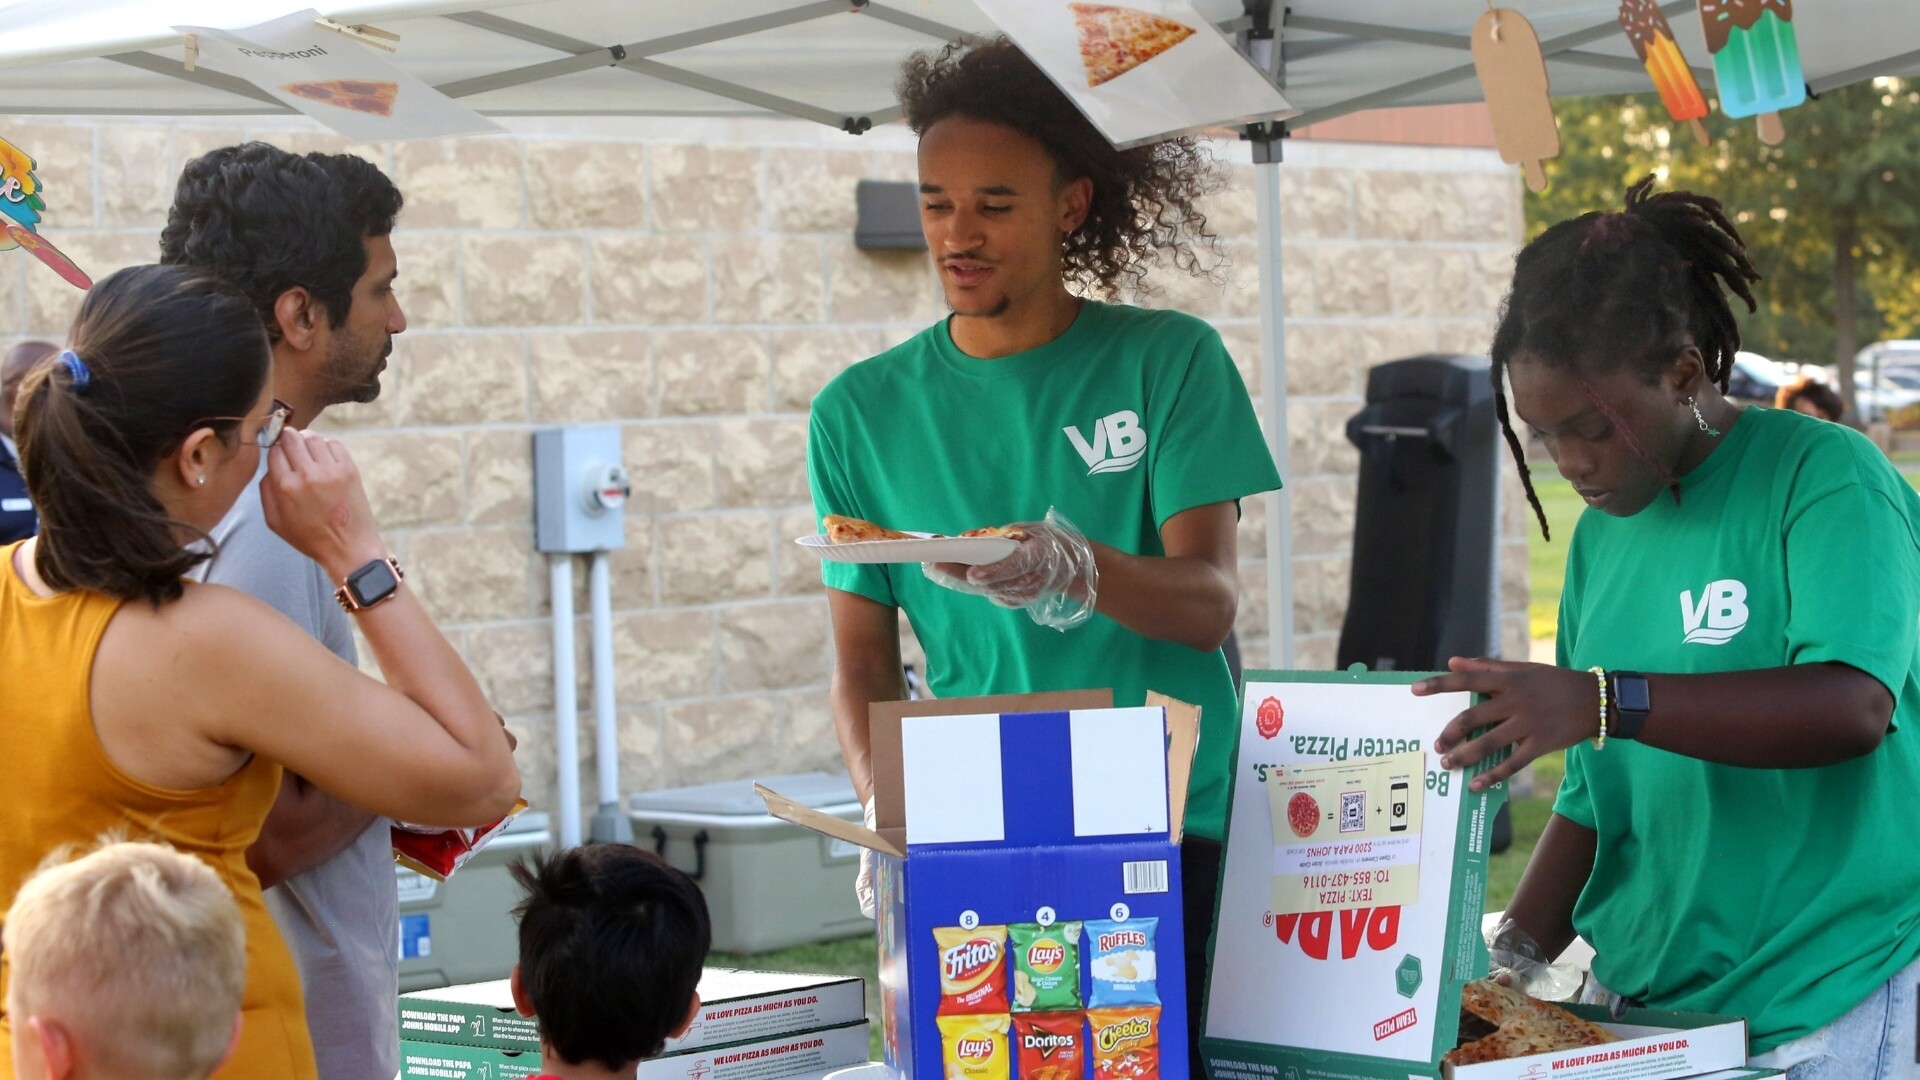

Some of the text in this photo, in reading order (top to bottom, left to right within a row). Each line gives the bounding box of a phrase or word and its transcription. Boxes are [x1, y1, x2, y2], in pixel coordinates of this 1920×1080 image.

[1063, 410, 1147, 470] VB
[1680, 579, 1749, 638] VB
[1290, 735, 1421, 762] Better Pizza.
[1468, 809, 1478, 852] REHEATING
[1476, 793, 1487, 854] INSTRUCTIONS:
[1306, 846, 1332, 858] JOHNS
[1334, 844, 1354, 855] PAPA
[1354, 842, 1372, 854] $200
[1304, 869, 1390, 888] TO: 855-437-0116
[1320, 888, 1372, 904] TEXT: PIZZA
[965, 915, 973, 926] 8
[1041, 912, 1050, 922] 4
[1115, 907, 1124, 918] 6
[1100, 931, 1146, 952] RUFFLES
[944, 941, 998, 979] Fritos
[1030, 946, 1062, 966] Lay's
[402, 1010, 466, 1024] DOWNLOAD THE PAPA
[706, 996, 818, 1020] WE LOVE PIZZA AS MUCH AS YOU DO.
[402, 1020, 460, 1034] JOHNS MOBILE APP
[1375, 1010, 1416, 1039] TEAM PIZZA
[1024, 1034, 1074, 1048] Doritos
[1099, 1018, 1150, 1052] Cheetos
[714, 1038, 824, 1066] WE LOVE PIZZA AS MUCH AS YOU DO.
[960, 1038, 992, 1058] Lay's
[1552, 1040, 1690, 1070] WE LOVE PIZZA AS MUCH AS YOU DO.
[406, 1056, 472, 1070] DOWNLOAD THE PAPA
[1210, 1058, 1278, 1074] DOWNLOAD THE PAPA
[407, 1066, 466, 1080] JOHNS MOBILE APP
